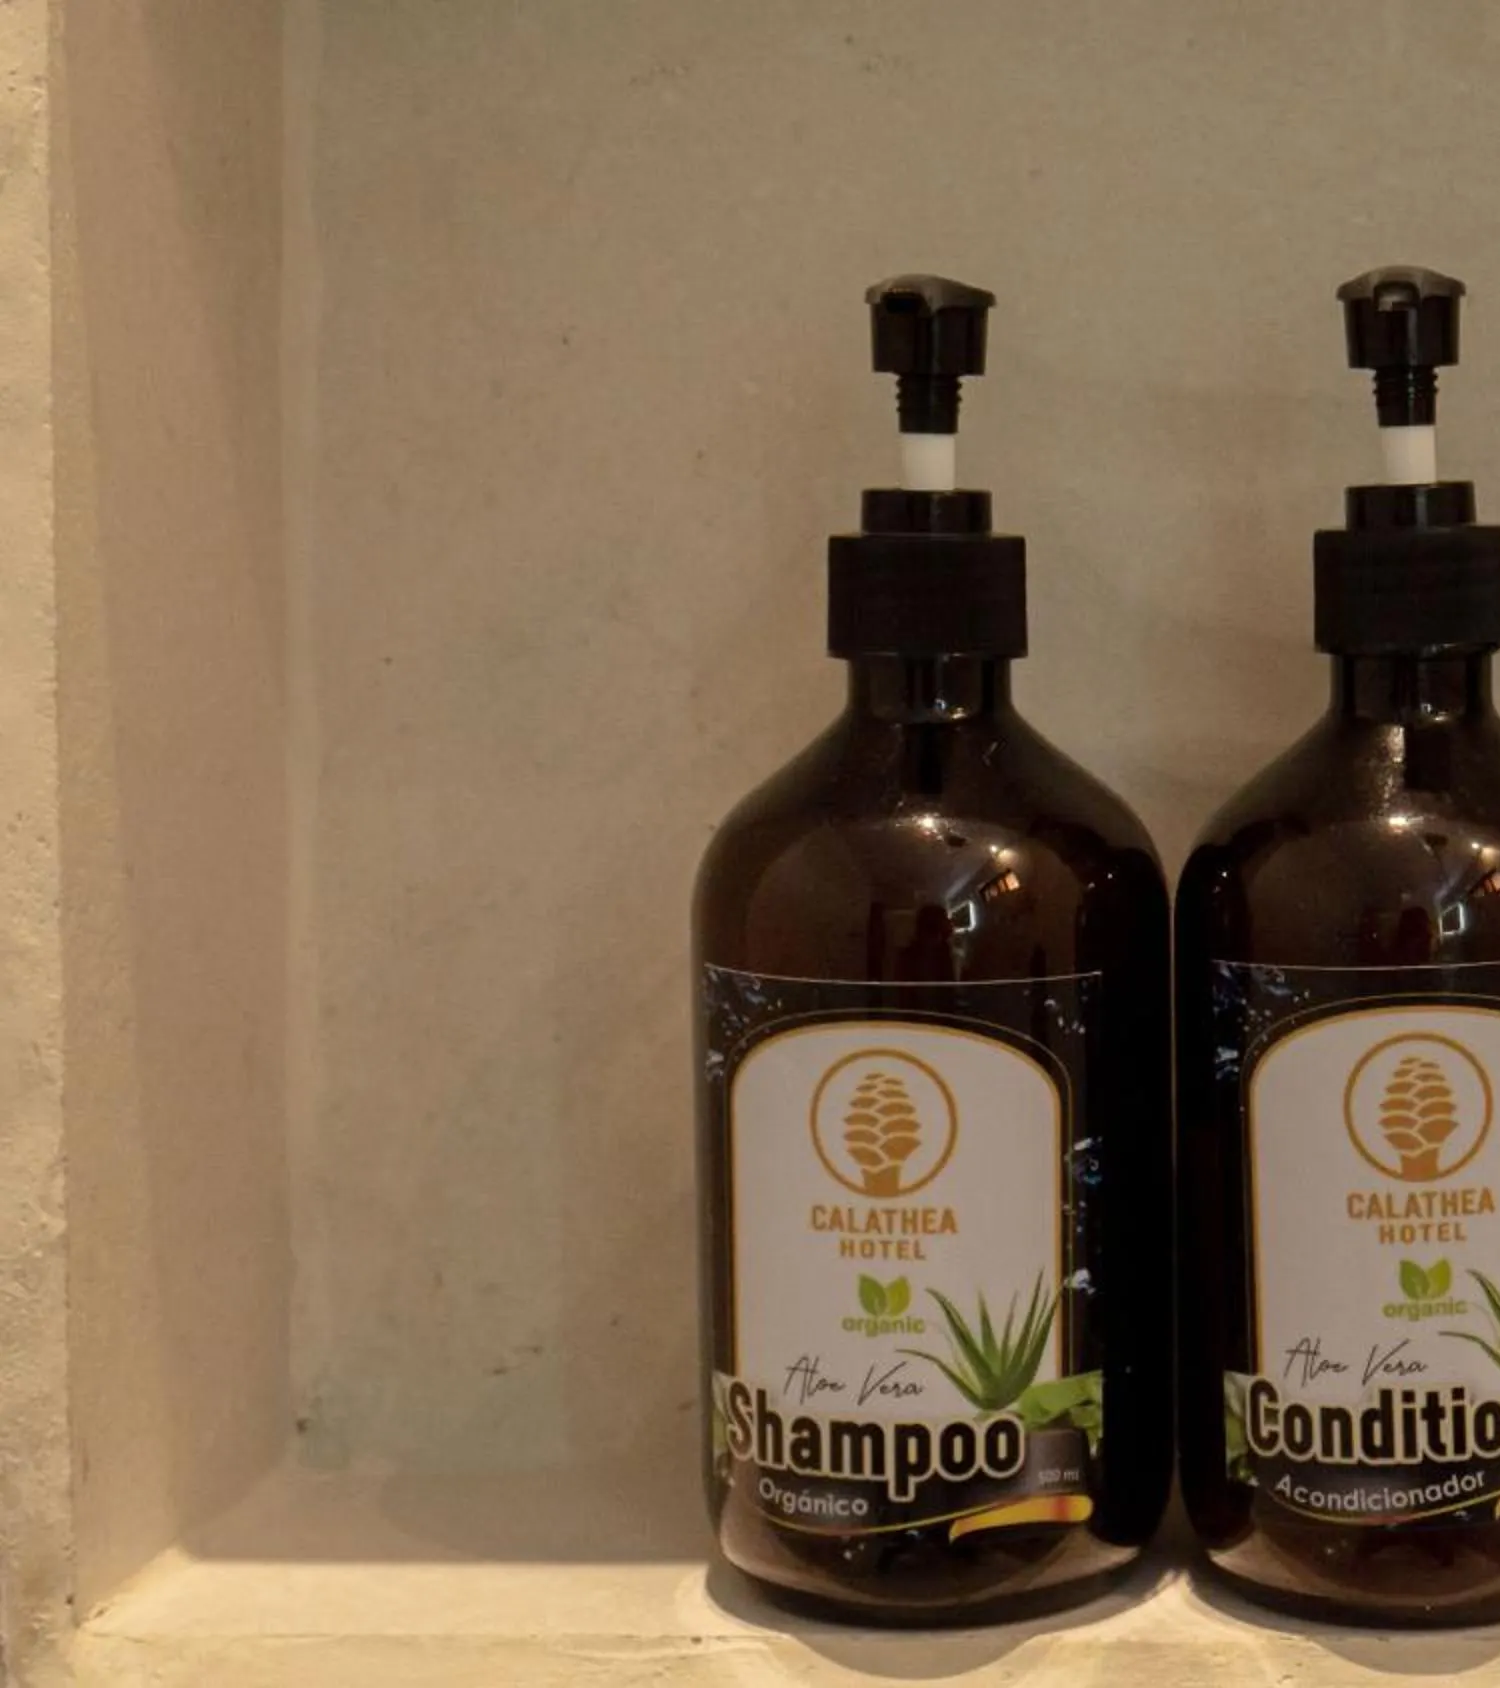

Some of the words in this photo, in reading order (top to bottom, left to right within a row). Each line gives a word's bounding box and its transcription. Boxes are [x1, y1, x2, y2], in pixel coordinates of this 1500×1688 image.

[809, 1204, 959, 1235] CALATHEA
[1347, 1187, 1495, 1220] CALATHEA
[839, 1239, 927, 1261] HOTEL
[1378, 1222, 1468, 1245] HOTEL
[841, 1313, 926, 1338] organic
[1382, 1297, 1468, 1322] organic
[1283, 1337, 1349, 1388] Aloe
[1361, 1338, 1429, 1386] Vera
[782, 1353, 845, 1405] Aloe
[857, 1361, 924, 1407] Vera
[725, 1378, 1027, 1502] Shampoo
[758, 1476, 869, 1517] Orgánico
[1274, 1470, 1486, 1513] Acondicionador
